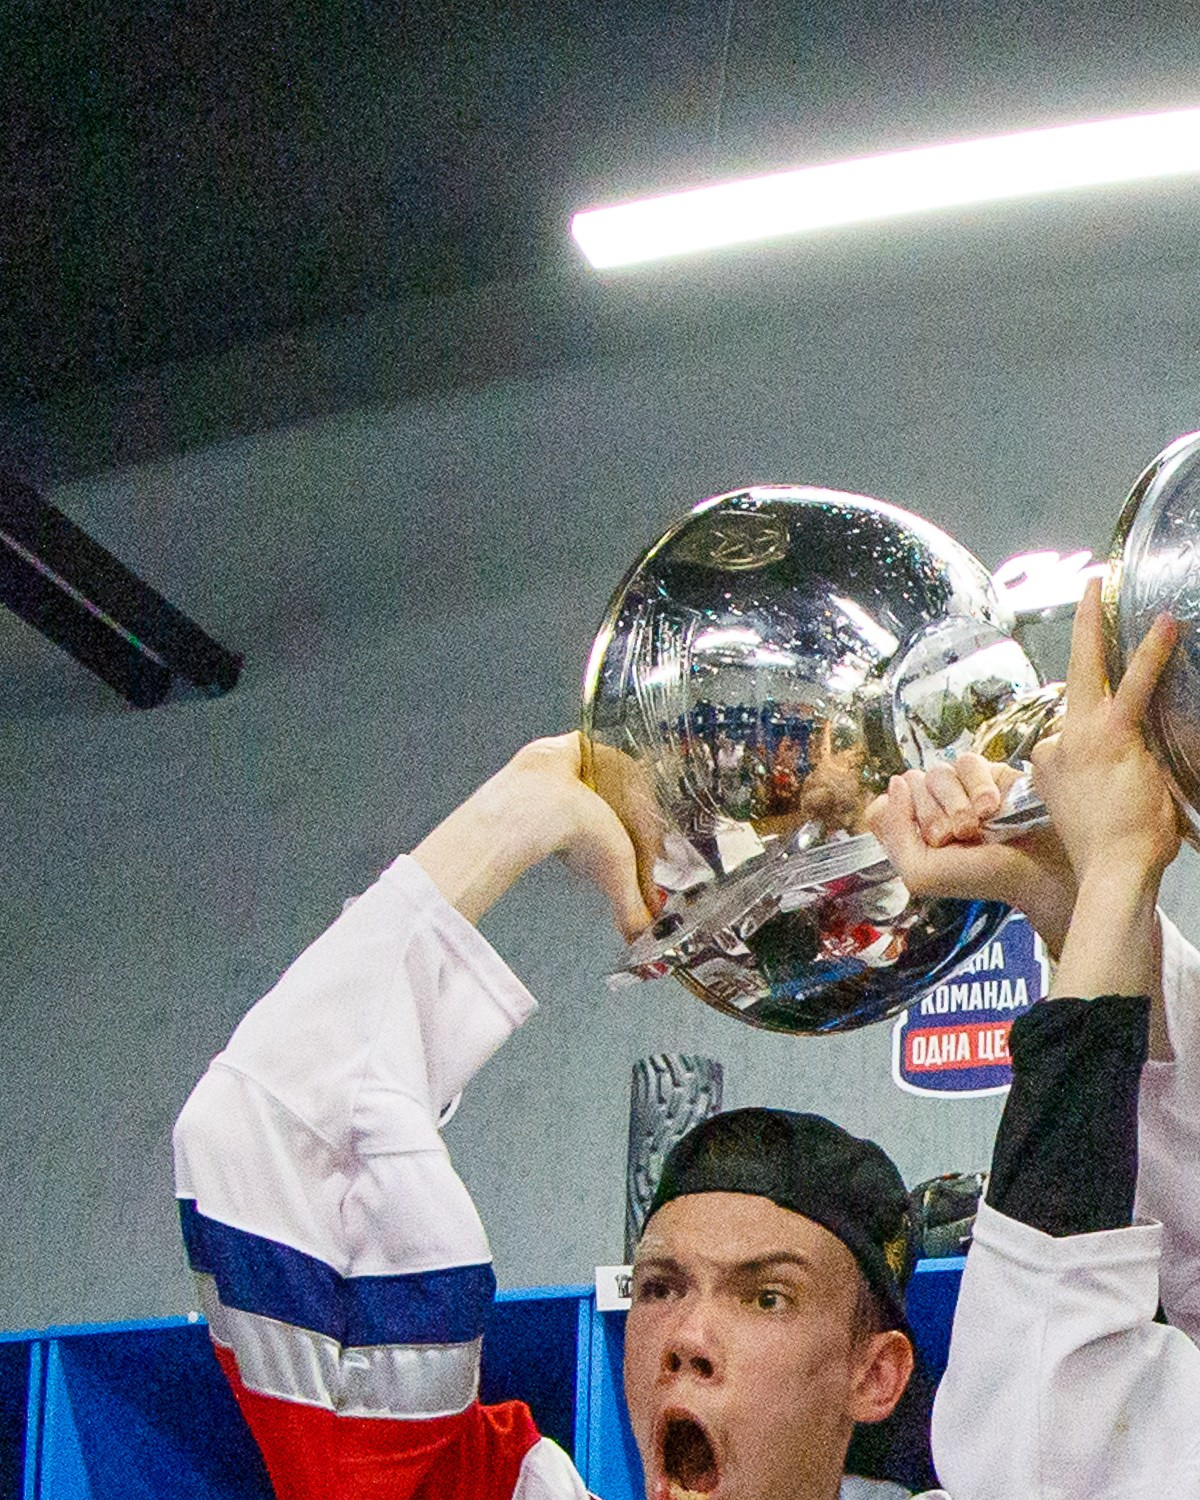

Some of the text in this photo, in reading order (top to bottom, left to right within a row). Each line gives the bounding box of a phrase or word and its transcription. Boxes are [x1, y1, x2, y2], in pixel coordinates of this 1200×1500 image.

[921, 977, 1028, 1016] КОМАНДА
[912, 1029, 1010, 1067] ОДНА ЦЕ
